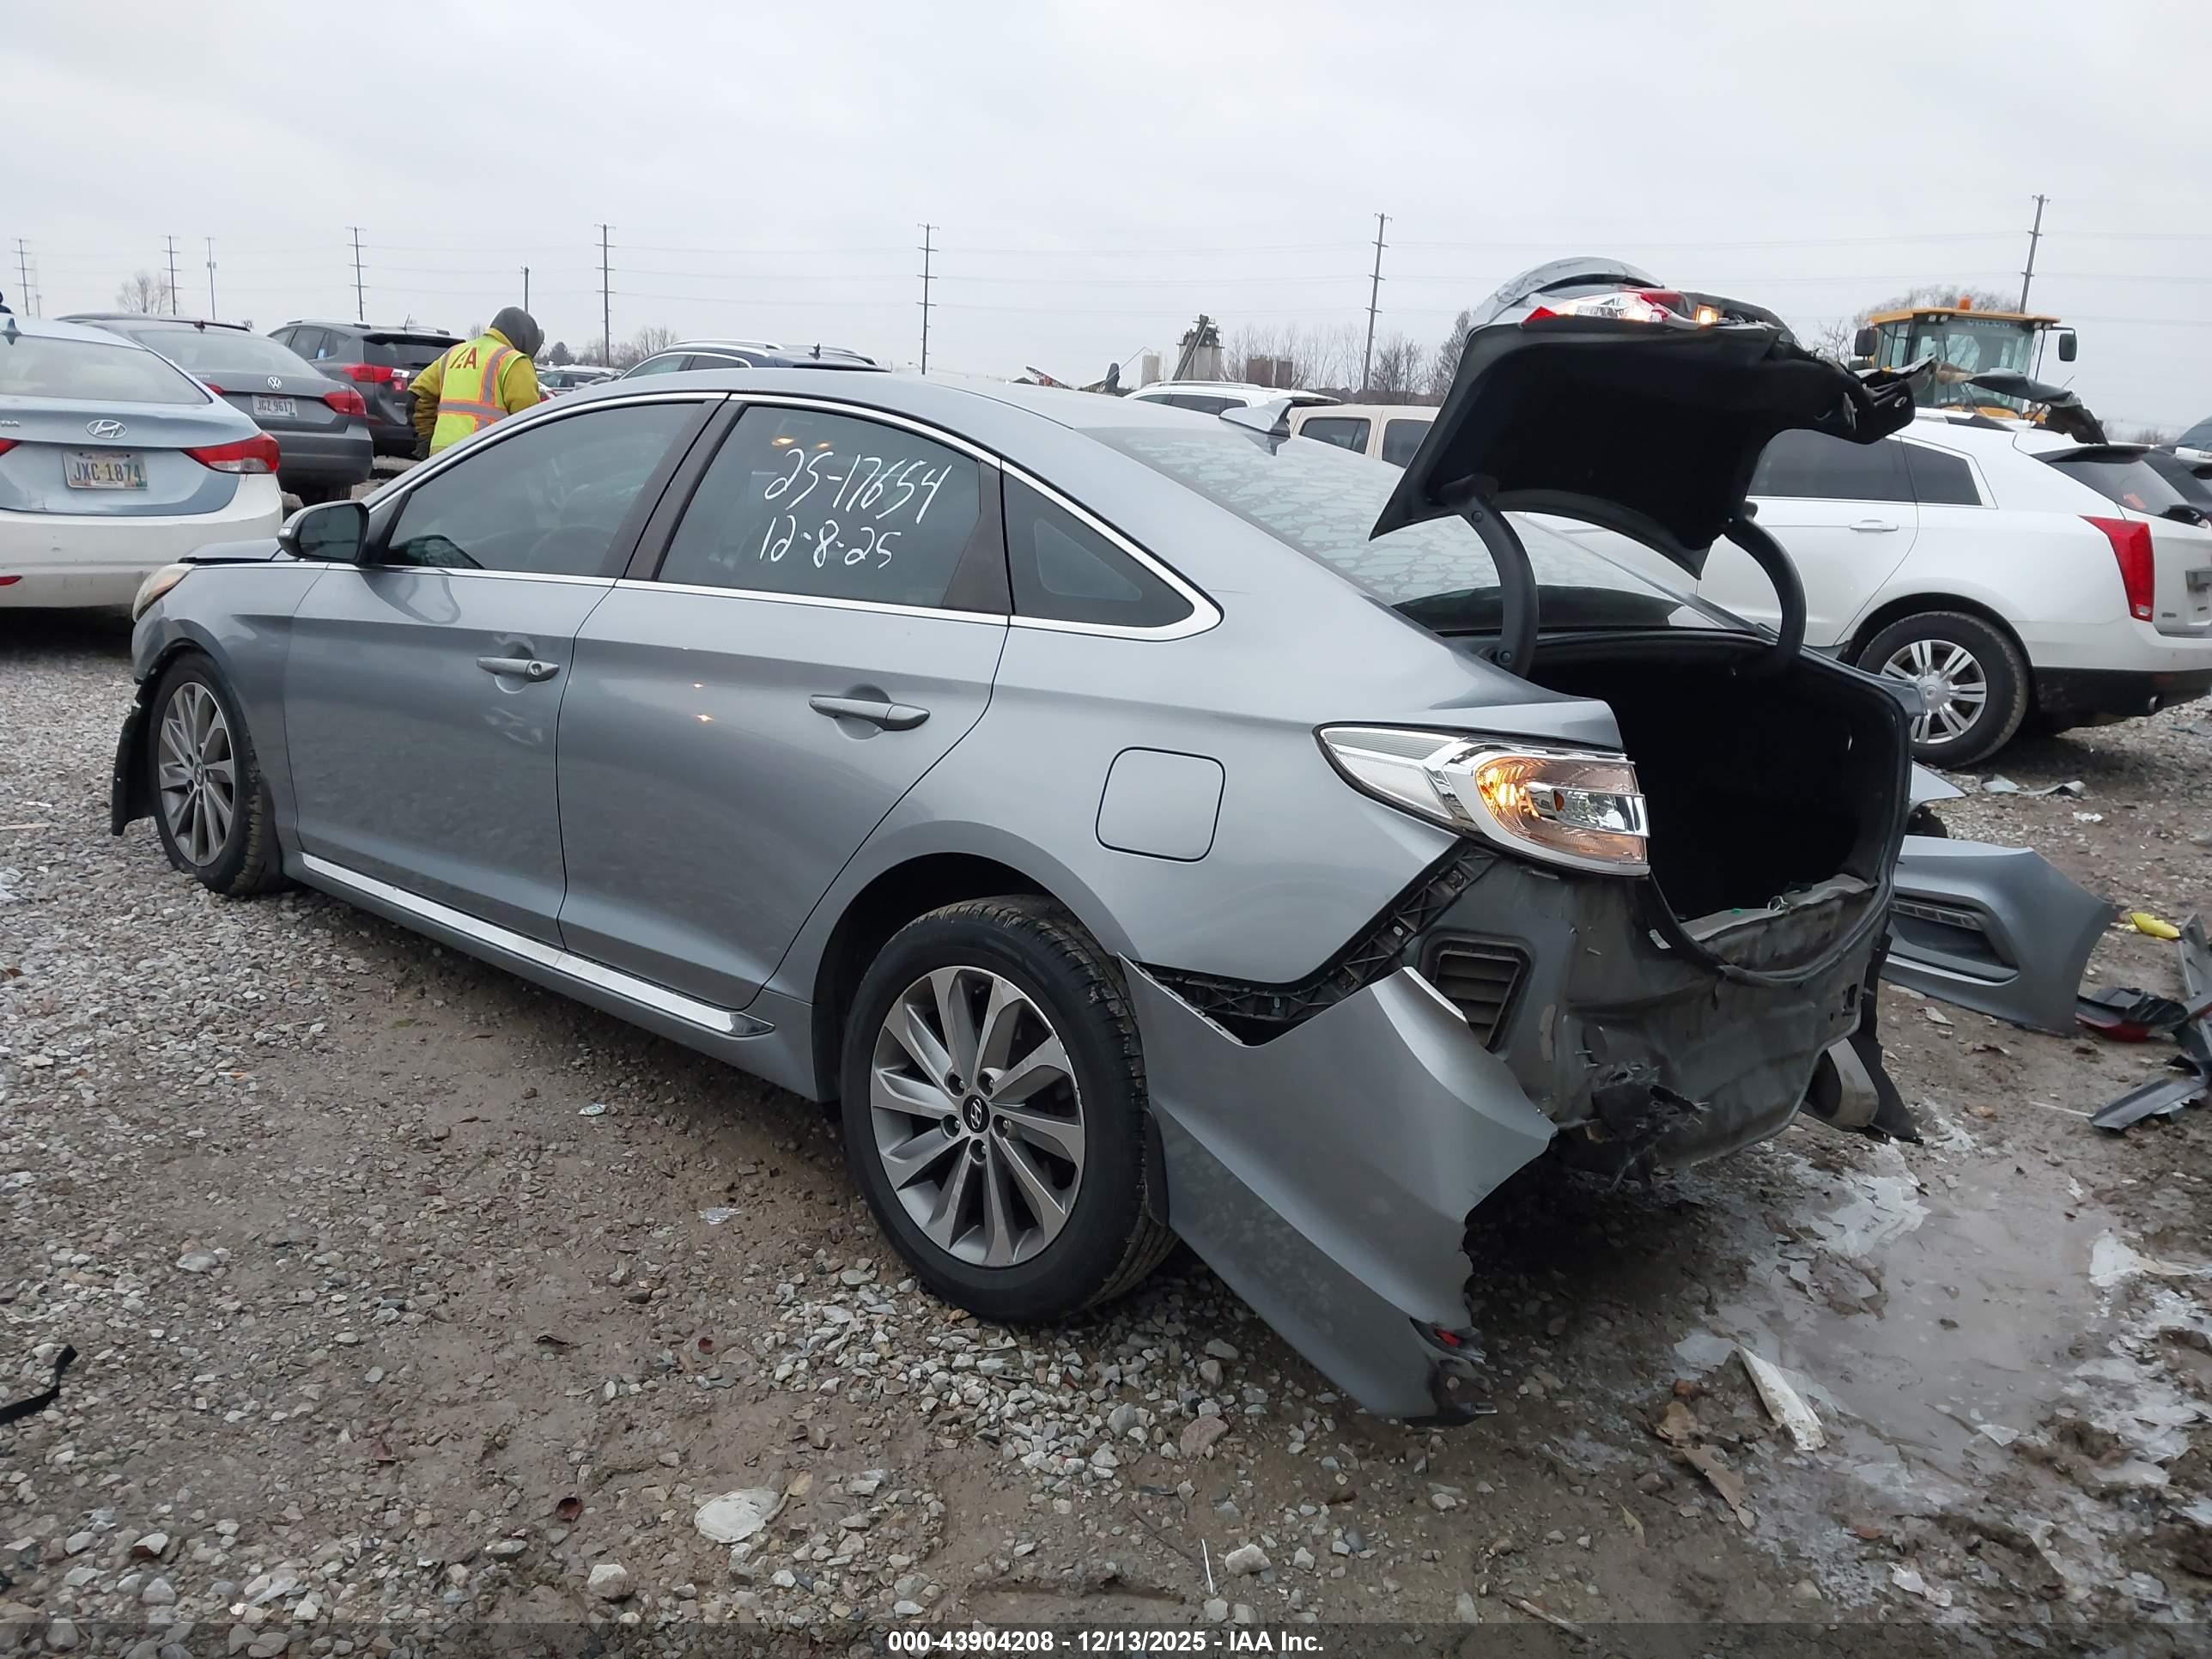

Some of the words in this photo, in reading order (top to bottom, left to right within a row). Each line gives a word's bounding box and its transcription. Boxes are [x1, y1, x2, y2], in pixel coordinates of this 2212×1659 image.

[274, 400, 293, 412] 9617
[74, 462, 100, 481] JXC
[104, 463, 142, 482] 1874
[764, 447, 952, 525] 25-17654
[759, 514, 902, 569] 12-8-25
